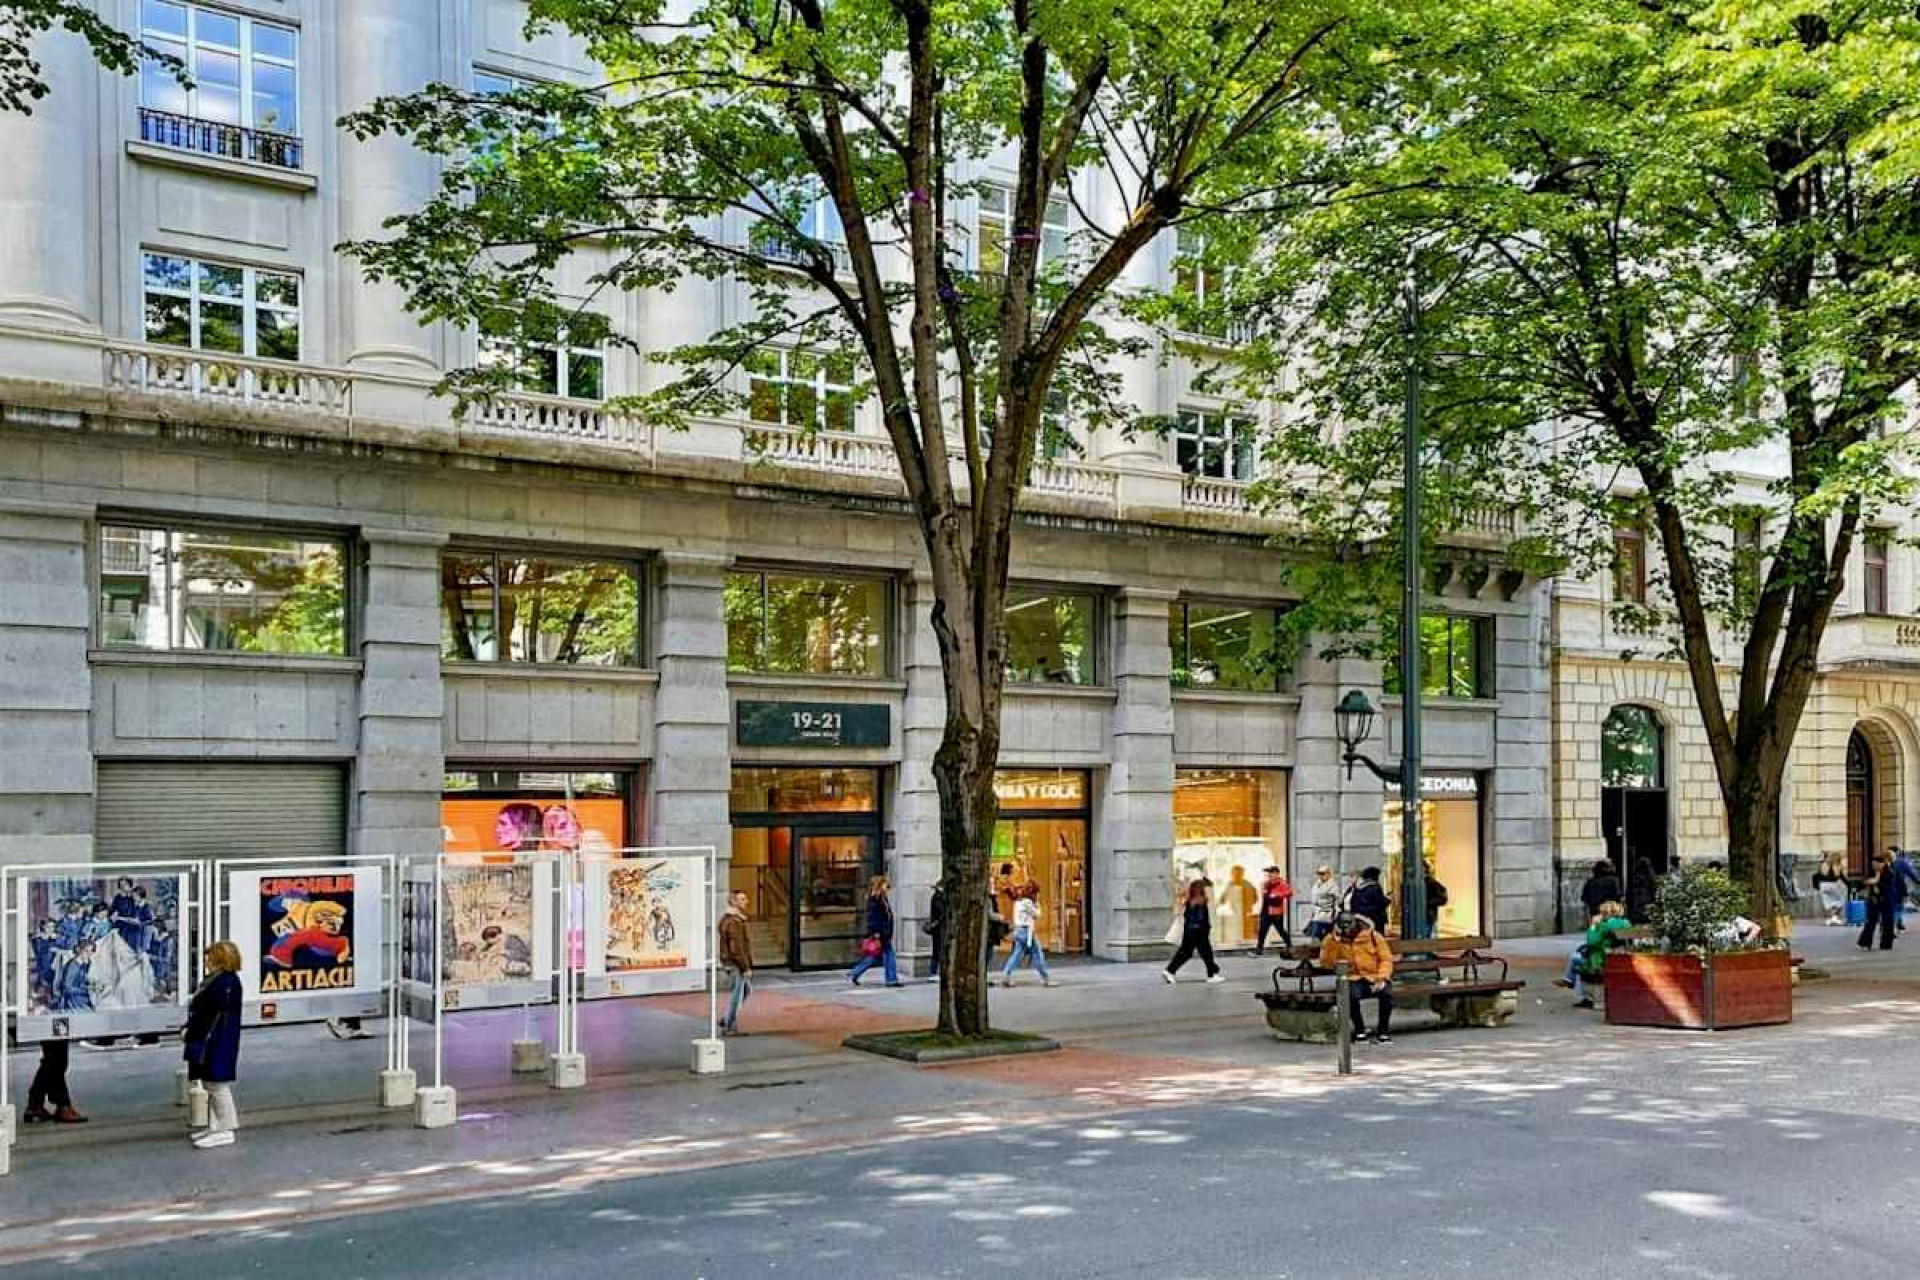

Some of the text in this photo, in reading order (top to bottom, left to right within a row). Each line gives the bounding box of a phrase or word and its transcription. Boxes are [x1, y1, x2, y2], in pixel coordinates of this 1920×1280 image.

[792, 711, 841, 729] 19-21
[1026, 782, 1038, 799] Y
[1041, 782, 1077, 799] LOLA
[1385, 776, 1477, 791] CEDONIA
